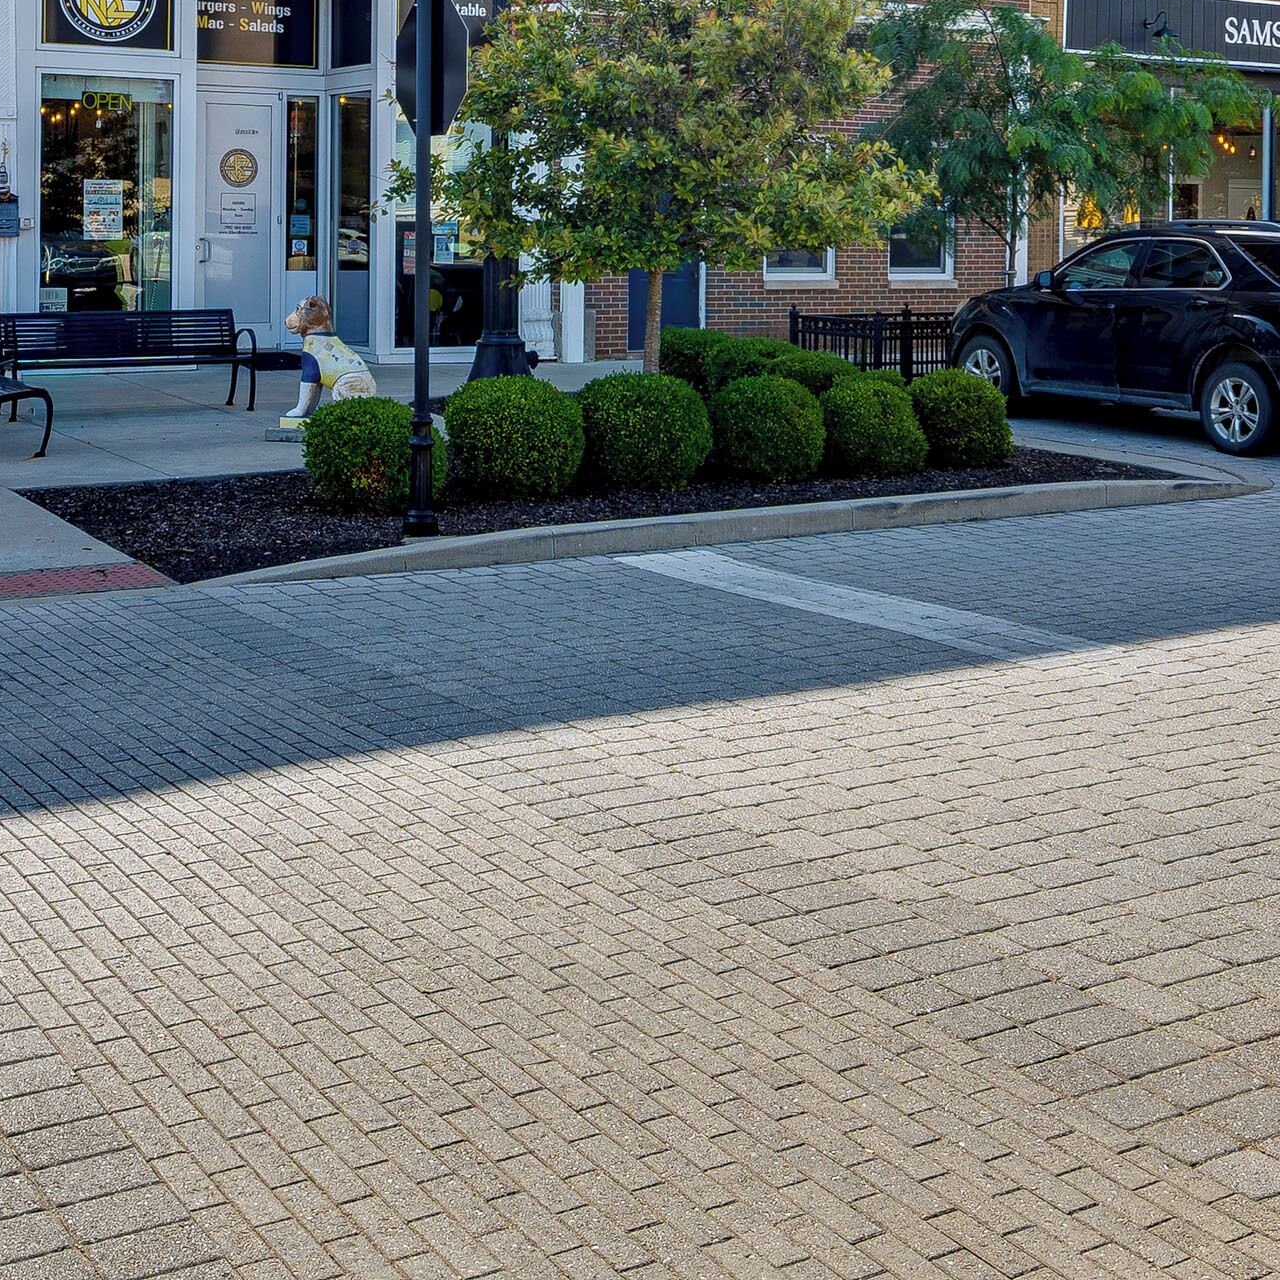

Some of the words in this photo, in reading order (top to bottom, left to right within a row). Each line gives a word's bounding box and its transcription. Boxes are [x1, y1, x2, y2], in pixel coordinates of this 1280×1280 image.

[251, 2, 292, 18] Wings
[197, 16, 225, 29] Mac
[239, 18, 285, 33] Salads
[82, 92, 132, 111] OPEN
